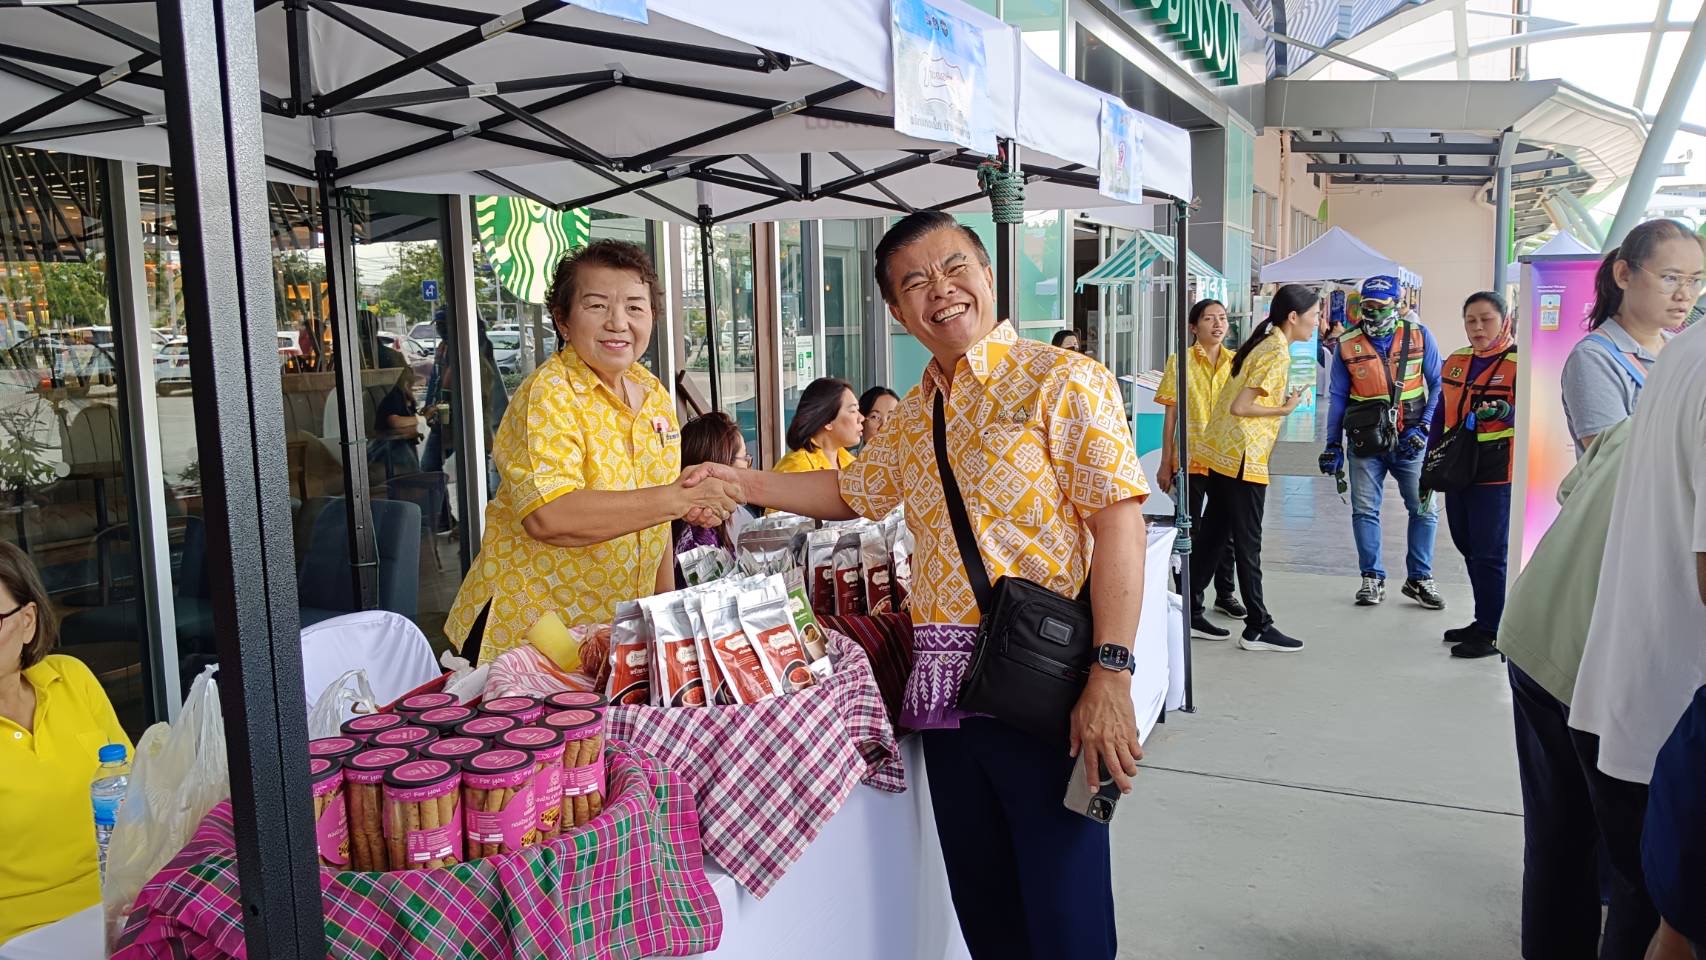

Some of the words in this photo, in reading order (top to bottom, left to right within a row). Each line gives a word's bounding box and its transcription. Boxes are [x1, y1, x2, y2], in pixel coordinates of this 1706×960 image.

[1354, 343, 1362, 355] 9
[491, 776, 505, 785] you
[427, 787, 441, 797] you
